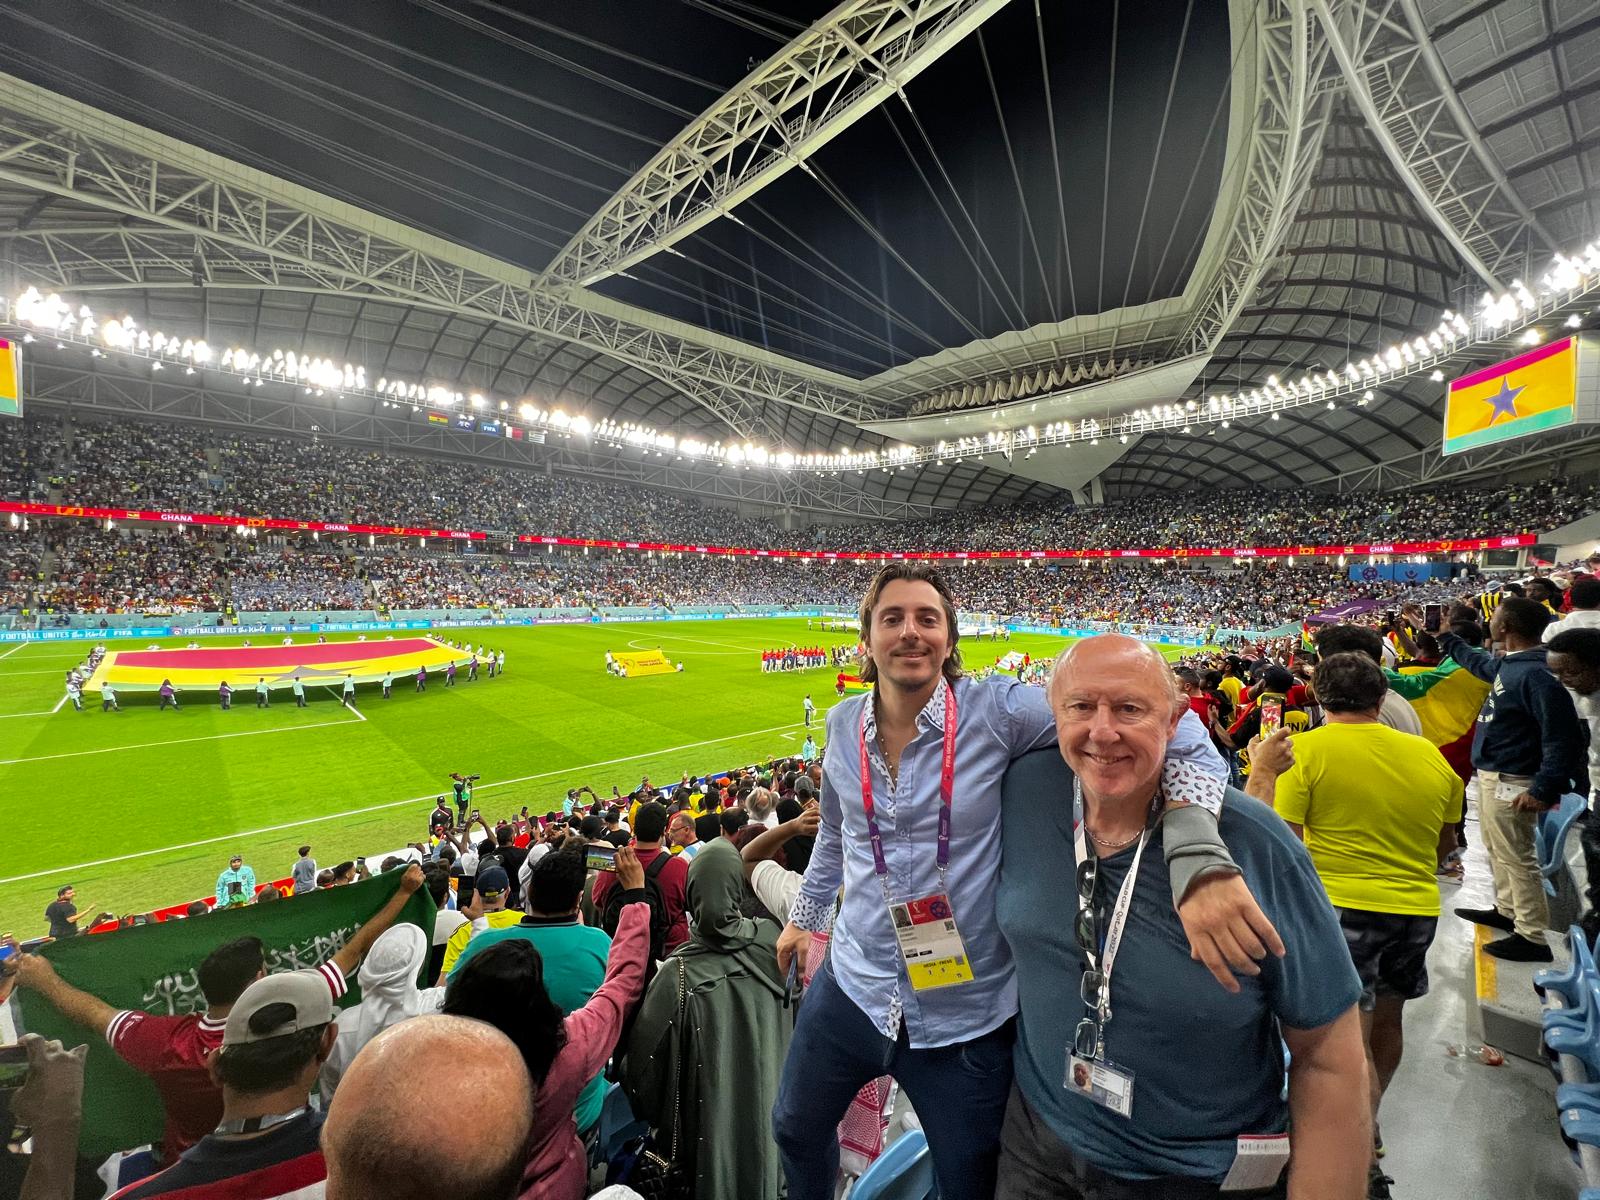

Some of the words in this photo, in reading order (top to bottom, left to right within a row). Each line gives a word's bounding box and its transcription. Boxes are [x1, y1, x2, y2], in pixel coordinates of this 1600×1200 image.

[161, 513, 193, 522] GHANA
[324, 523, 349, 532] GHANA
[1501, 537, 1520, 546] GHANA
[1369, 545, 1394, 553] GHANA
[0, 631, 40, 640] FOOTBALL
[42, 630, 70, 638] UNITES
[184, 627, 215, 635] FOOTBALL
